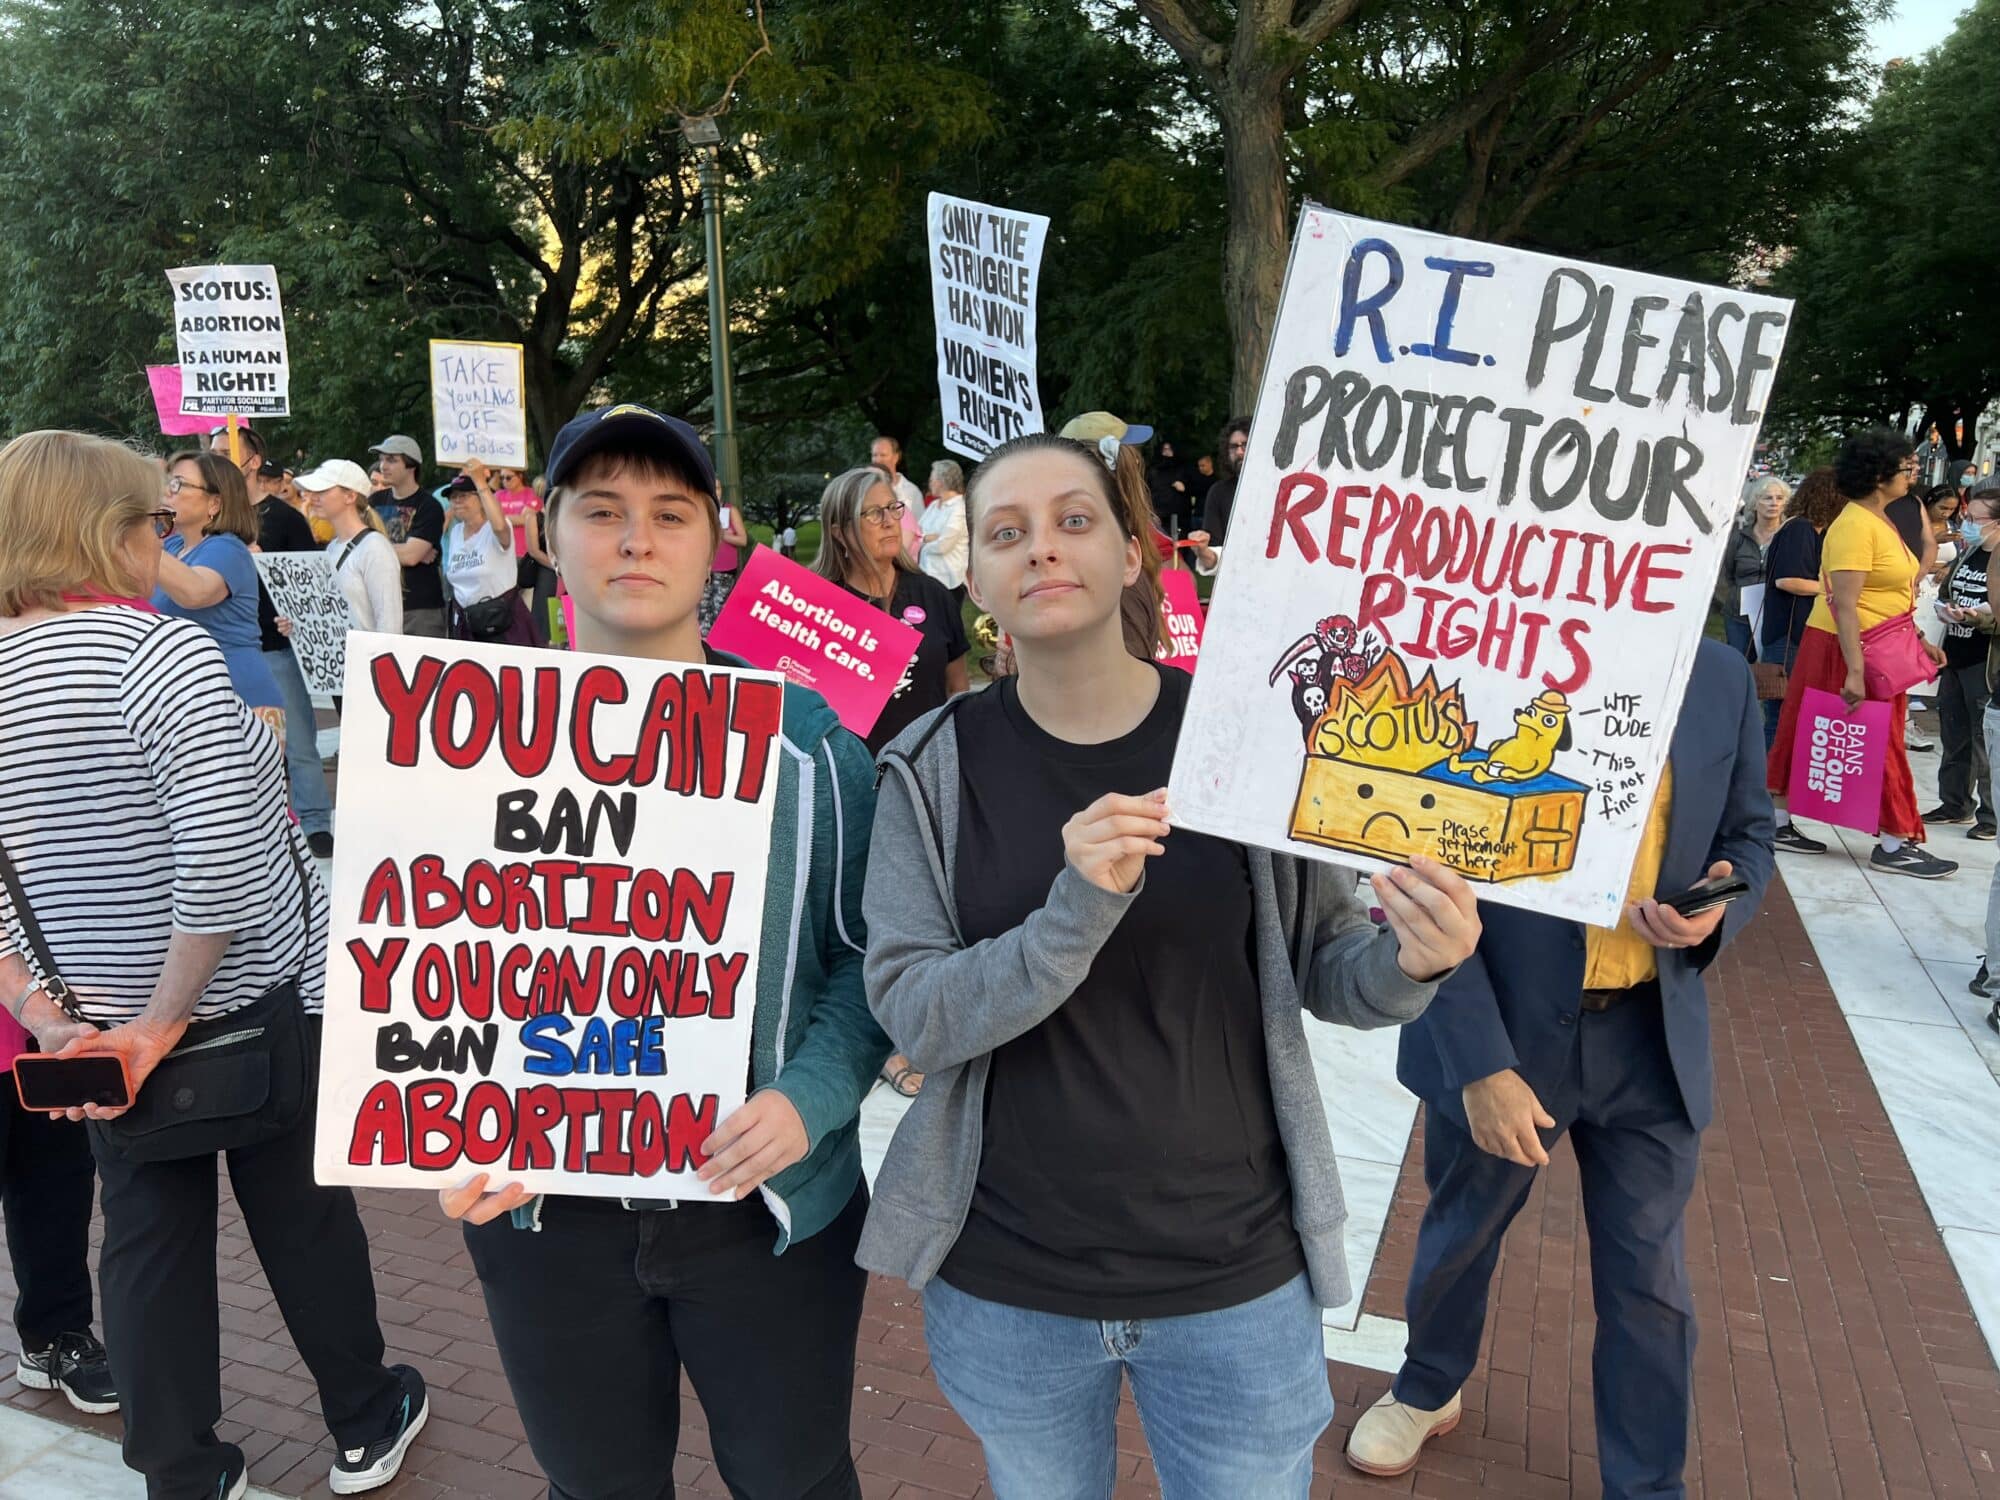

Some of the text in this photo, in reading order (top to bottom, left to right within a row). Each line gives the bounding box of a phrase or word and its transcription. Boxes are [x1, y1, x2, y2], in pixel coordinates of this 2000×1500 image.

[942, 203, 1030, 262] ONLY THE
[180, 281, 272, 301] SCOTUS:
[940, 243, 1029, 307] STRUGGLE
[180, 316, 281, 332] ABORTION
[948, 286, 1024, 349] HAS WON
[1334, 238, 1787, 426] R.I. PLEASE
[183, 351, 281, 364] IS A HUMAN
[196, 372, 276, 392] RIGHT!
[440, 356, 505, 384] TAKE
[943, 337, 1033, 411] WOMEN'S
[458, 410, 497, 430] OFF
[957, 385, 1024, 442] RIGHTS
[1273, 365, 1713, 535] PROTECT OUR
[1265, 471, 1693, 614] REPRODUCTIVE
[283, 591, 347, 622] Abortion
[285, 568, 315, 593] Keep
[300, 620, 333, 656] Safe
[749, 600, 875, 682] Health Care.
[760, 579, 879, 652] Abortion is
[1167, 614, 1199, 635] OUR
[1357, 572, 1593, 695] RIGHTS
[370, 652, 784, 804] YOU CANT
[1319, 700, 1462, 756] SCOTUS
[1603, 692, 1643, 718] WTF
[1603, 715, 1652, 738] DUDE
[1592, 749, 1636, 772] This
[1807, 715, 1830, 793] BODIES
[1824, 719, 1847, 803] OFF OUR
[1845, 723, 1867, 776] BANS
[1596, 771, 1645, 794] is not
[1599, 792, 1639, 820] fine
[494, 787, 638, 858] BAN
[1442, 819, 1489, 840] Please
[1446, 850, 1502, 871] of here
[358, 854, 736, 945] ABORTION
[347, 938, 749, 1021] YOU CAN ONLY
[376, 1013, 668, 1077] BAN SAFE
[347, 1079, 718, 1179] ABORTION
